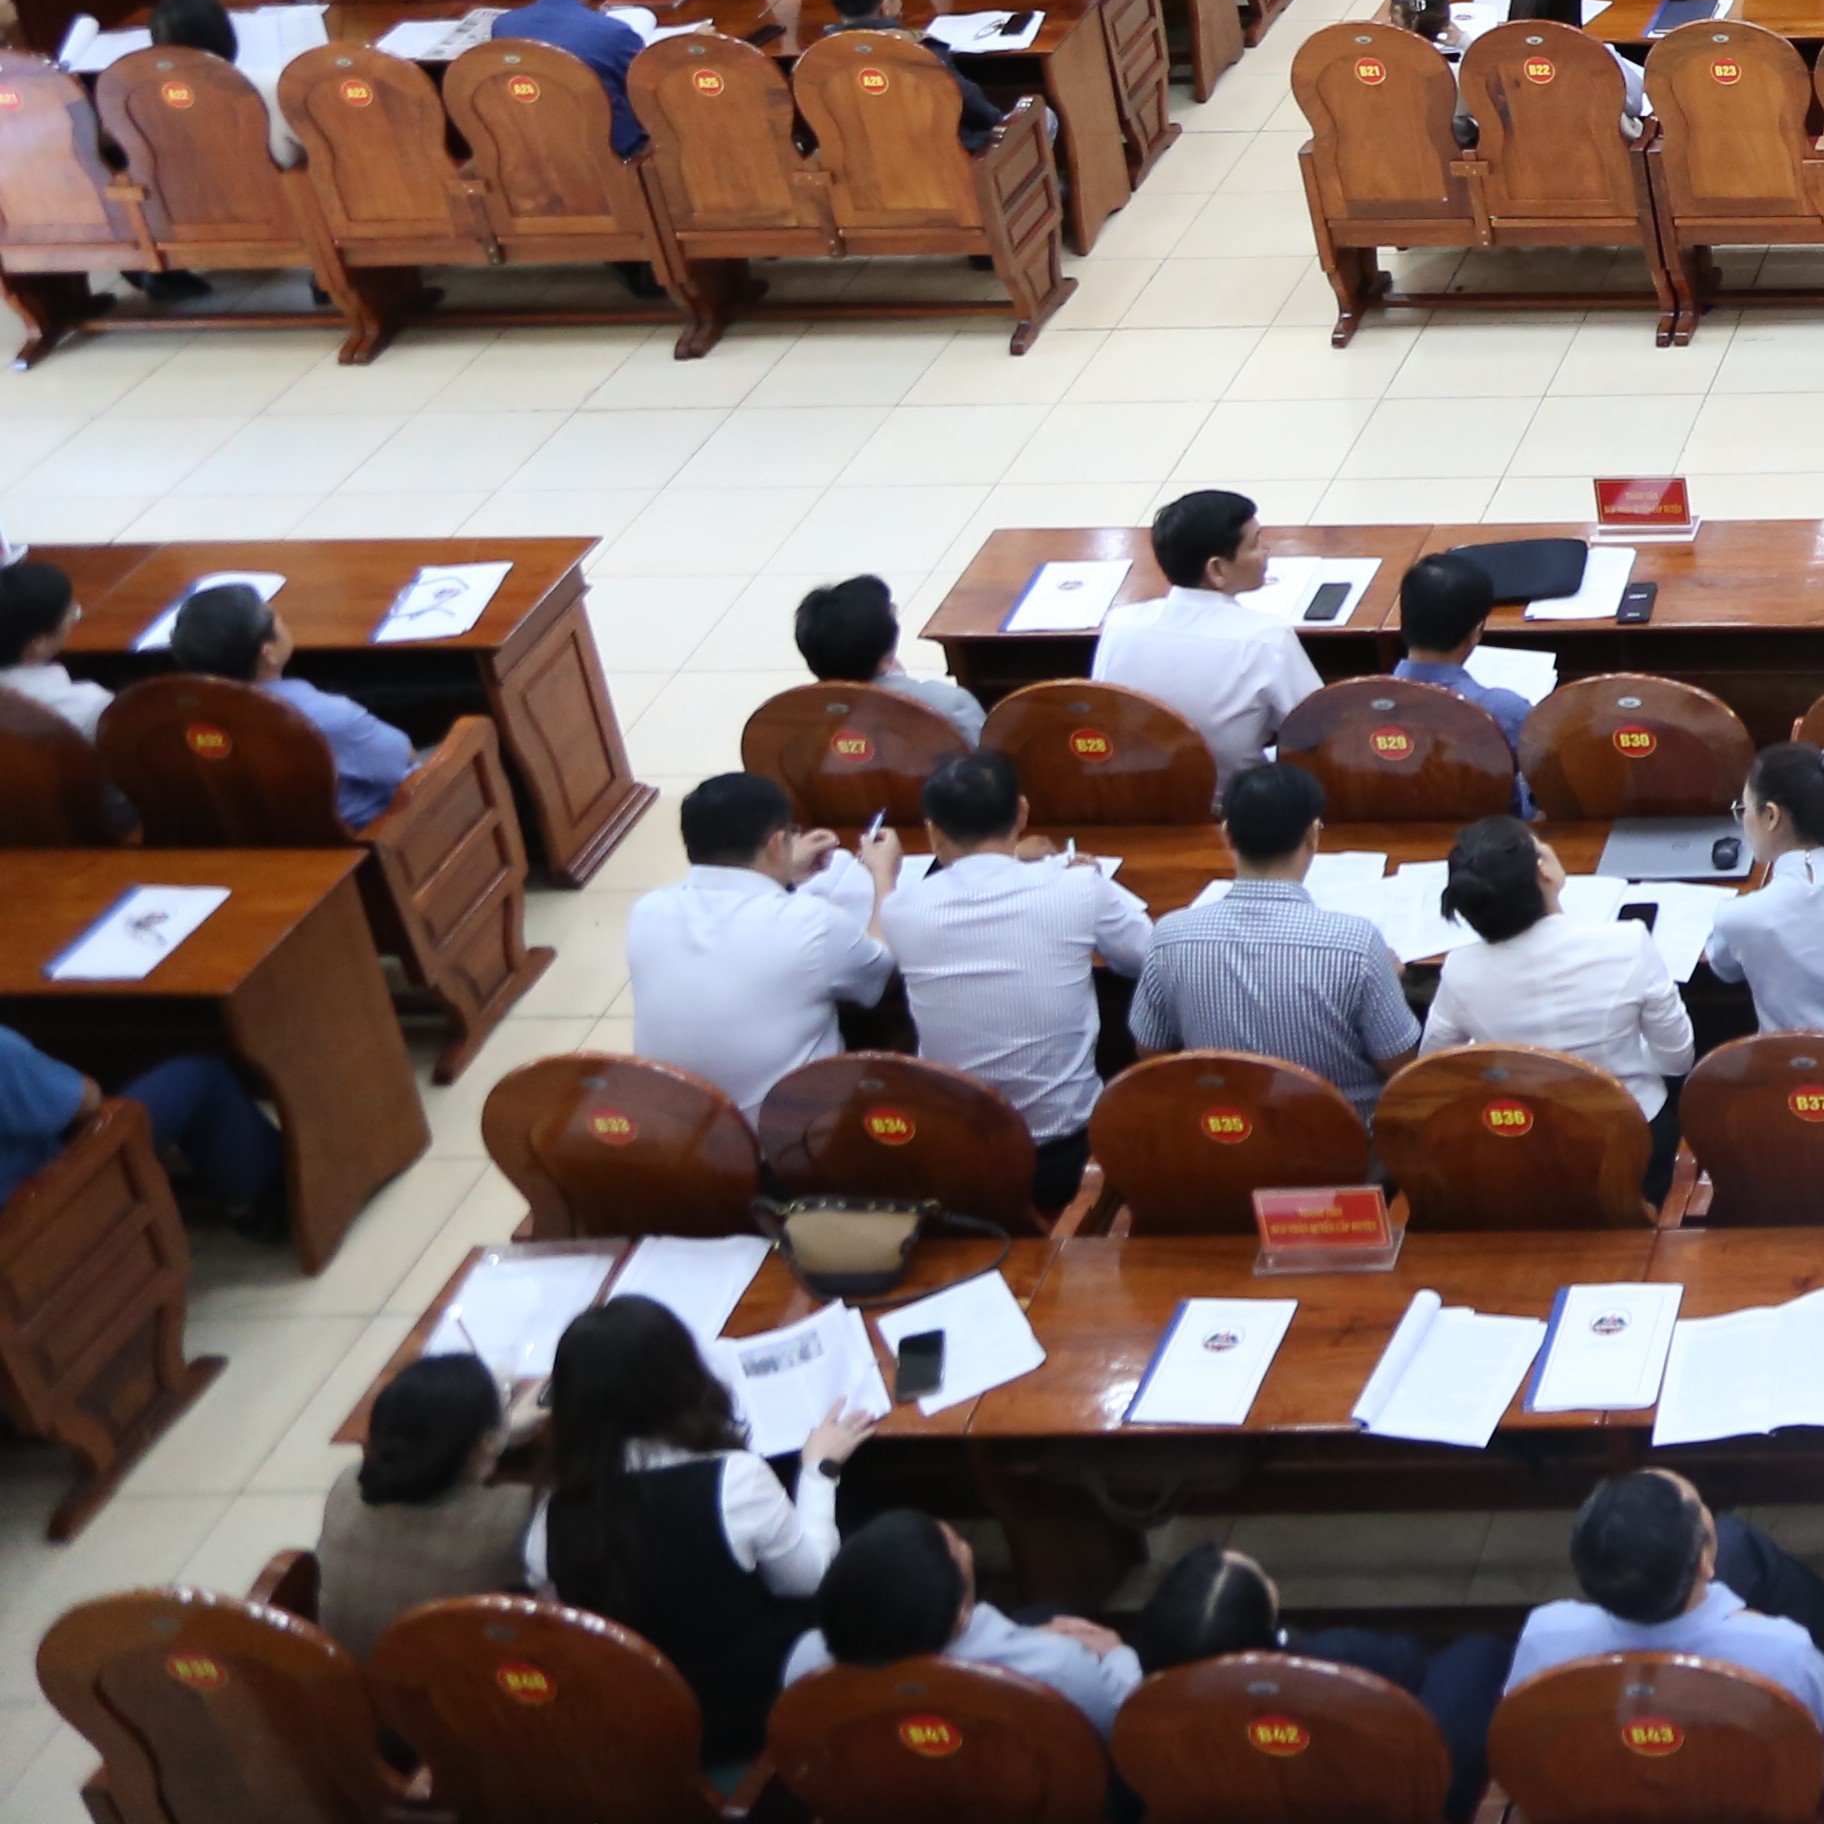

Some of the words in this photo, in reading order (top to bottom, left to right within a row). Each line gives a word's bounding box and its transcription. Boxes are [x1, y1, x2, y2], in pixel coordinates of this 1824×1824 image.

[1358, 65, 1381, 77] B21
[1528, 64, 1552, 77] B22
[1714, 65, 1737, 77] B23
